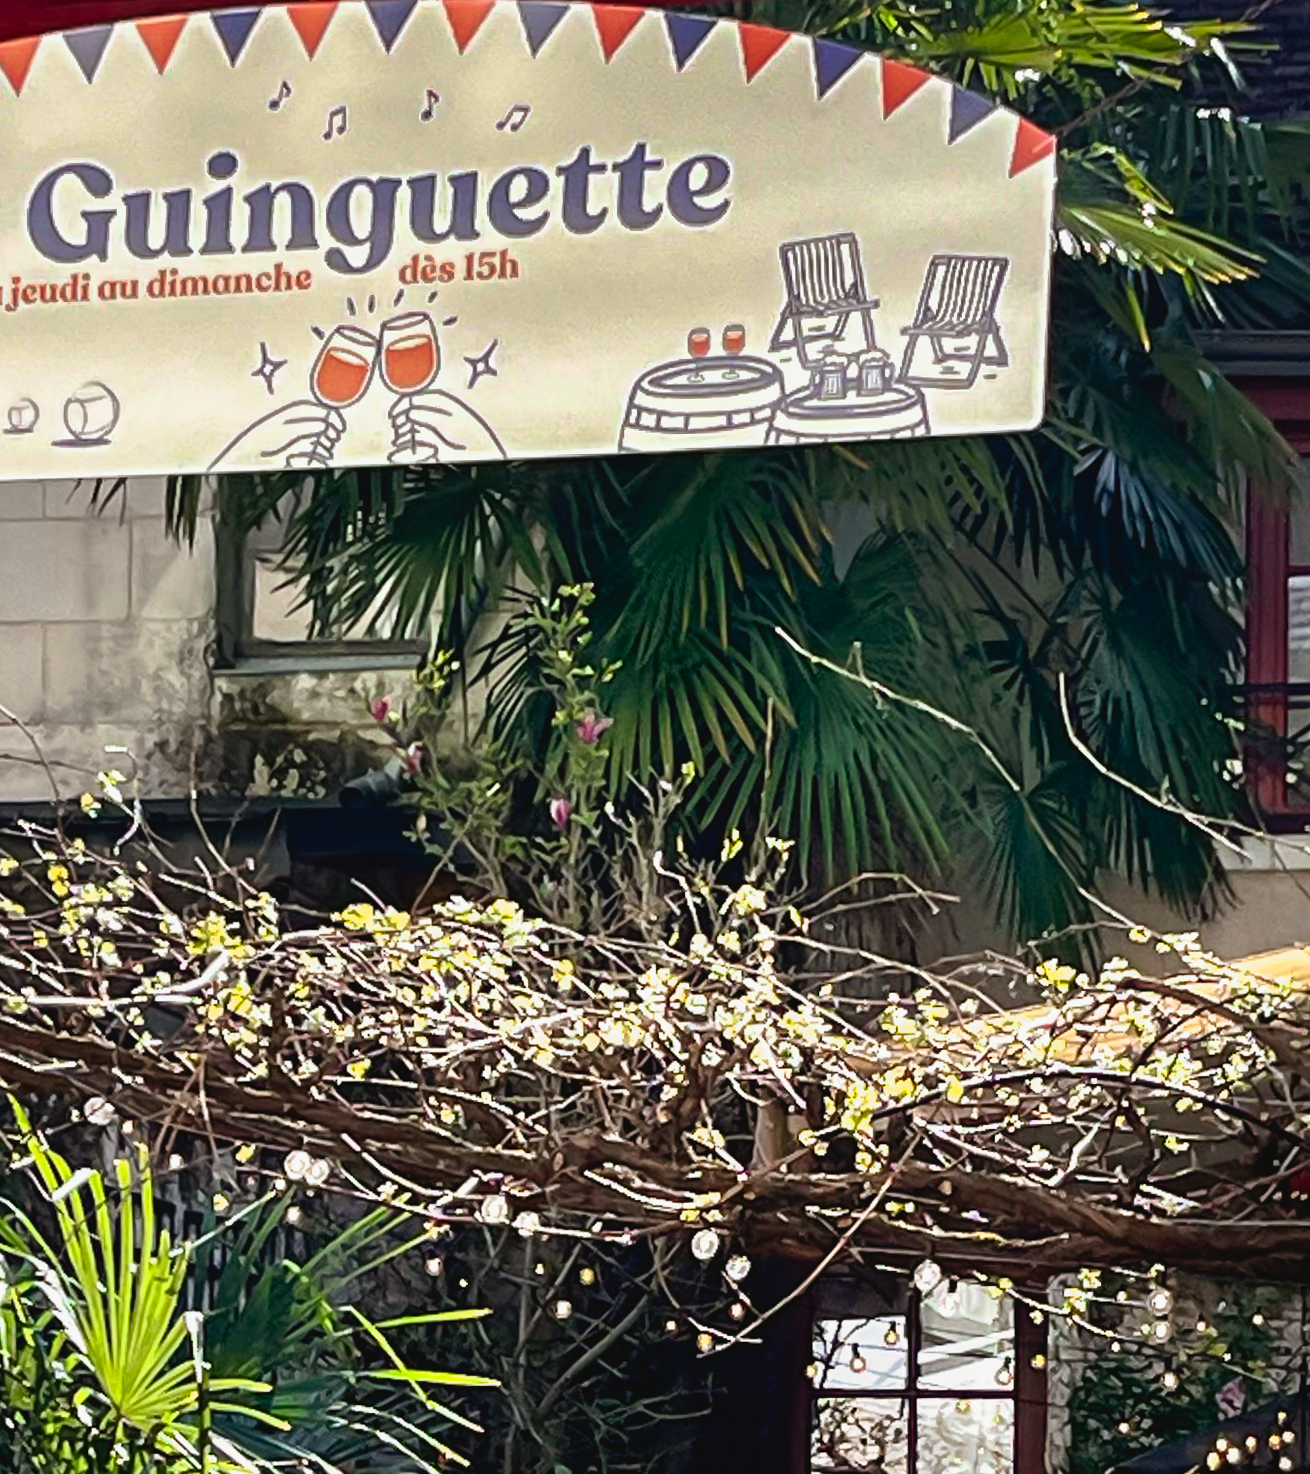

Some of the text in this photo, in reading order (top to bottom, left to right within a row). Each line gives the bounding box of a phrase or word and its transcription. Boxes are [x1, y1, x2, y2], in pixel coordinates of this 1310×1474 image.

[27, 142, 733, 274] Guinguette
[4, 272, 91, 312] jeudi
[97, 279, 140, 300] au
[146, 262, 313, 299] dimanche
[398, 253, 456, 286] dès
[463, 248, 520, 281] 15h
